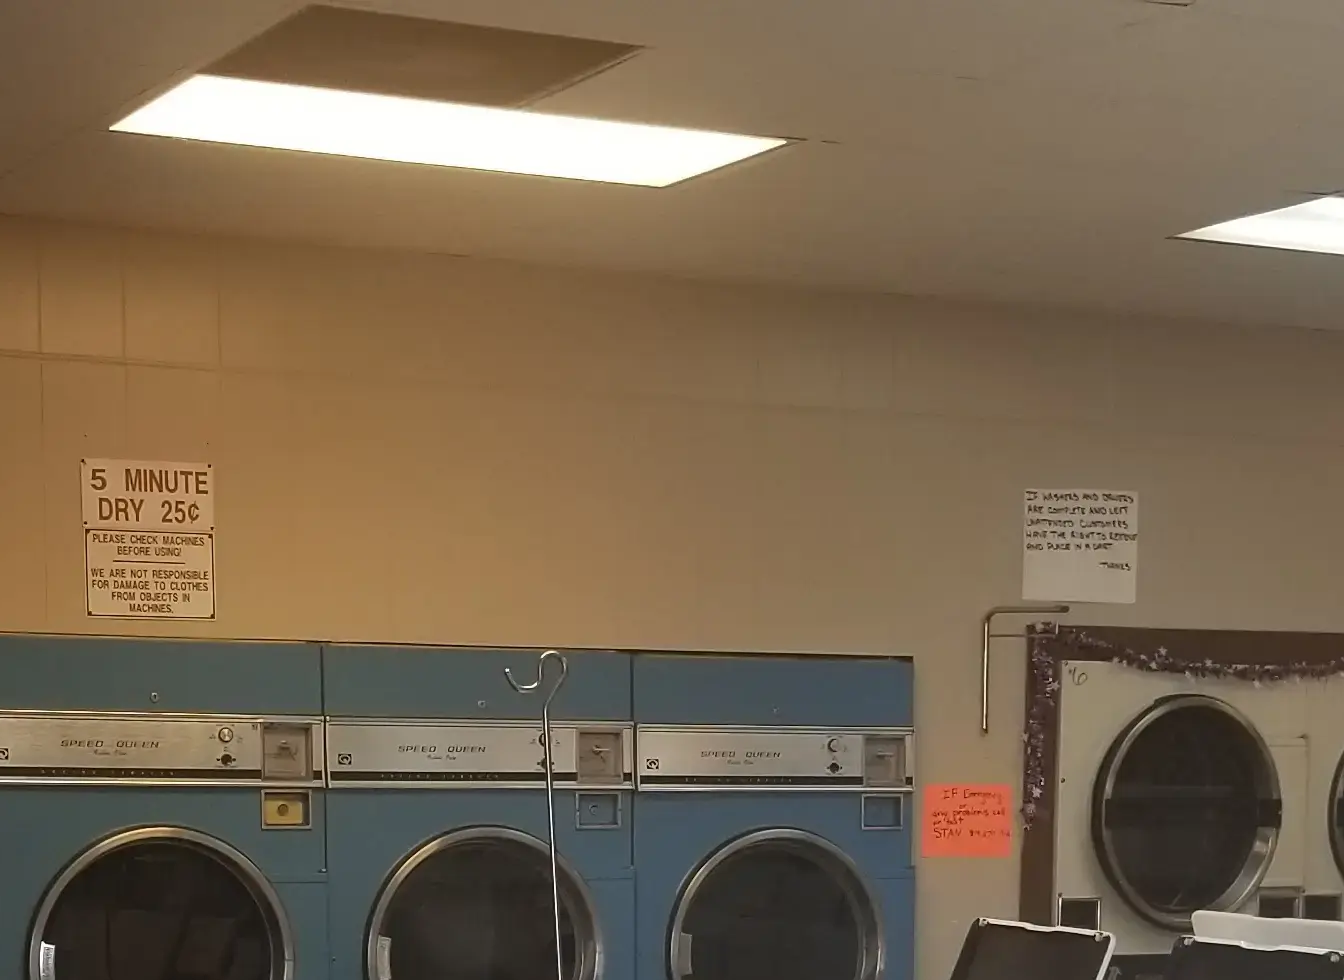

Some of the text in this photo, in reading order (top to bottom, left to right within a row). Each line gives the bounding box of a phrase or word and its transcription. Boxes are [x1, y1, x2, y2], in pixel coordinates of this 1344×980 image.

[90, 468, 209, 495] 5 MINUTE
[1082, 493, 1099, 501] AND
[98, 497, 200, 524] DRY 25¢
[1028, 505, 1044, 514] ARE
[1089, 507, 1107, 515] AND
[1109, 506, 1128, 515] LEFT
[93, 534, 205, 546] PLEASE CHECK MACHINES
[1050, 531, 1066, 539] THE
[117, 546, 182, 557] BEFORE USING!
[91, 569, 209, 580] WE ARE NOT RESPONSIBLE
[92, 580, 208, 592] FOR DAMAGE TO CLOTHES
[112, 592, 190, 602] FROM OBJECTS IN
[129, 604, 174, 614] MACHINES.
[60, 739, 160, 749] SPEED QUEEN
[397, 745, 486, 753] SPEED QUEEN
[700, 750, 781, 759] SPEED QUEEN
